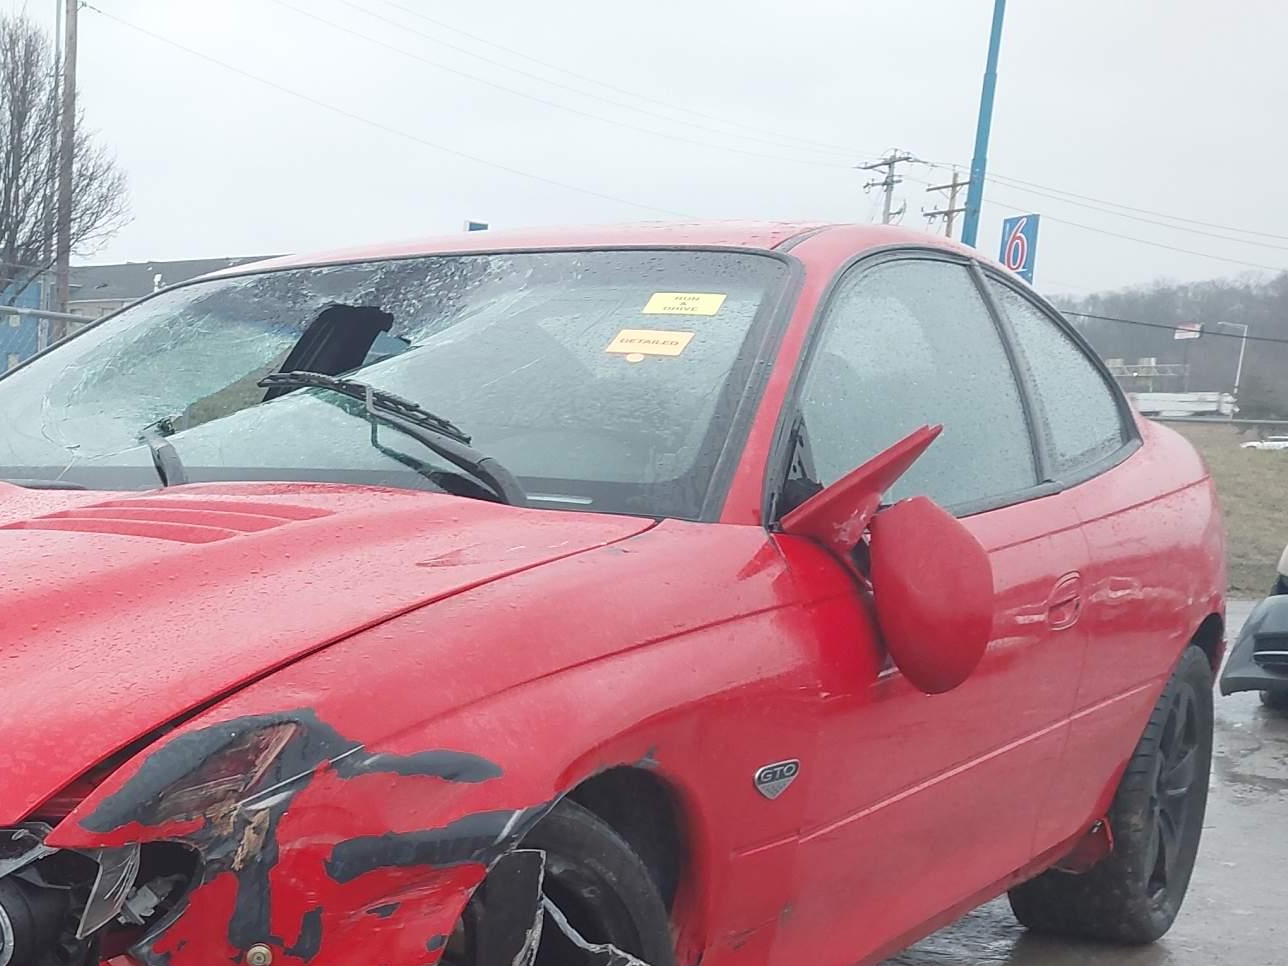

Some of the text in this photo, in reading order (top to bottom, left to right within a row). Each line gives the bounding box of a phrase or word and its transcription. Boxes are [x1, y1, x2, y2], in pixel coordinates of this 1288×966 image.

[1004, 217, 1028, 272] 6
[619, 337, 680, 347] DETAILED
[760, 763, 797, 782] GTO
